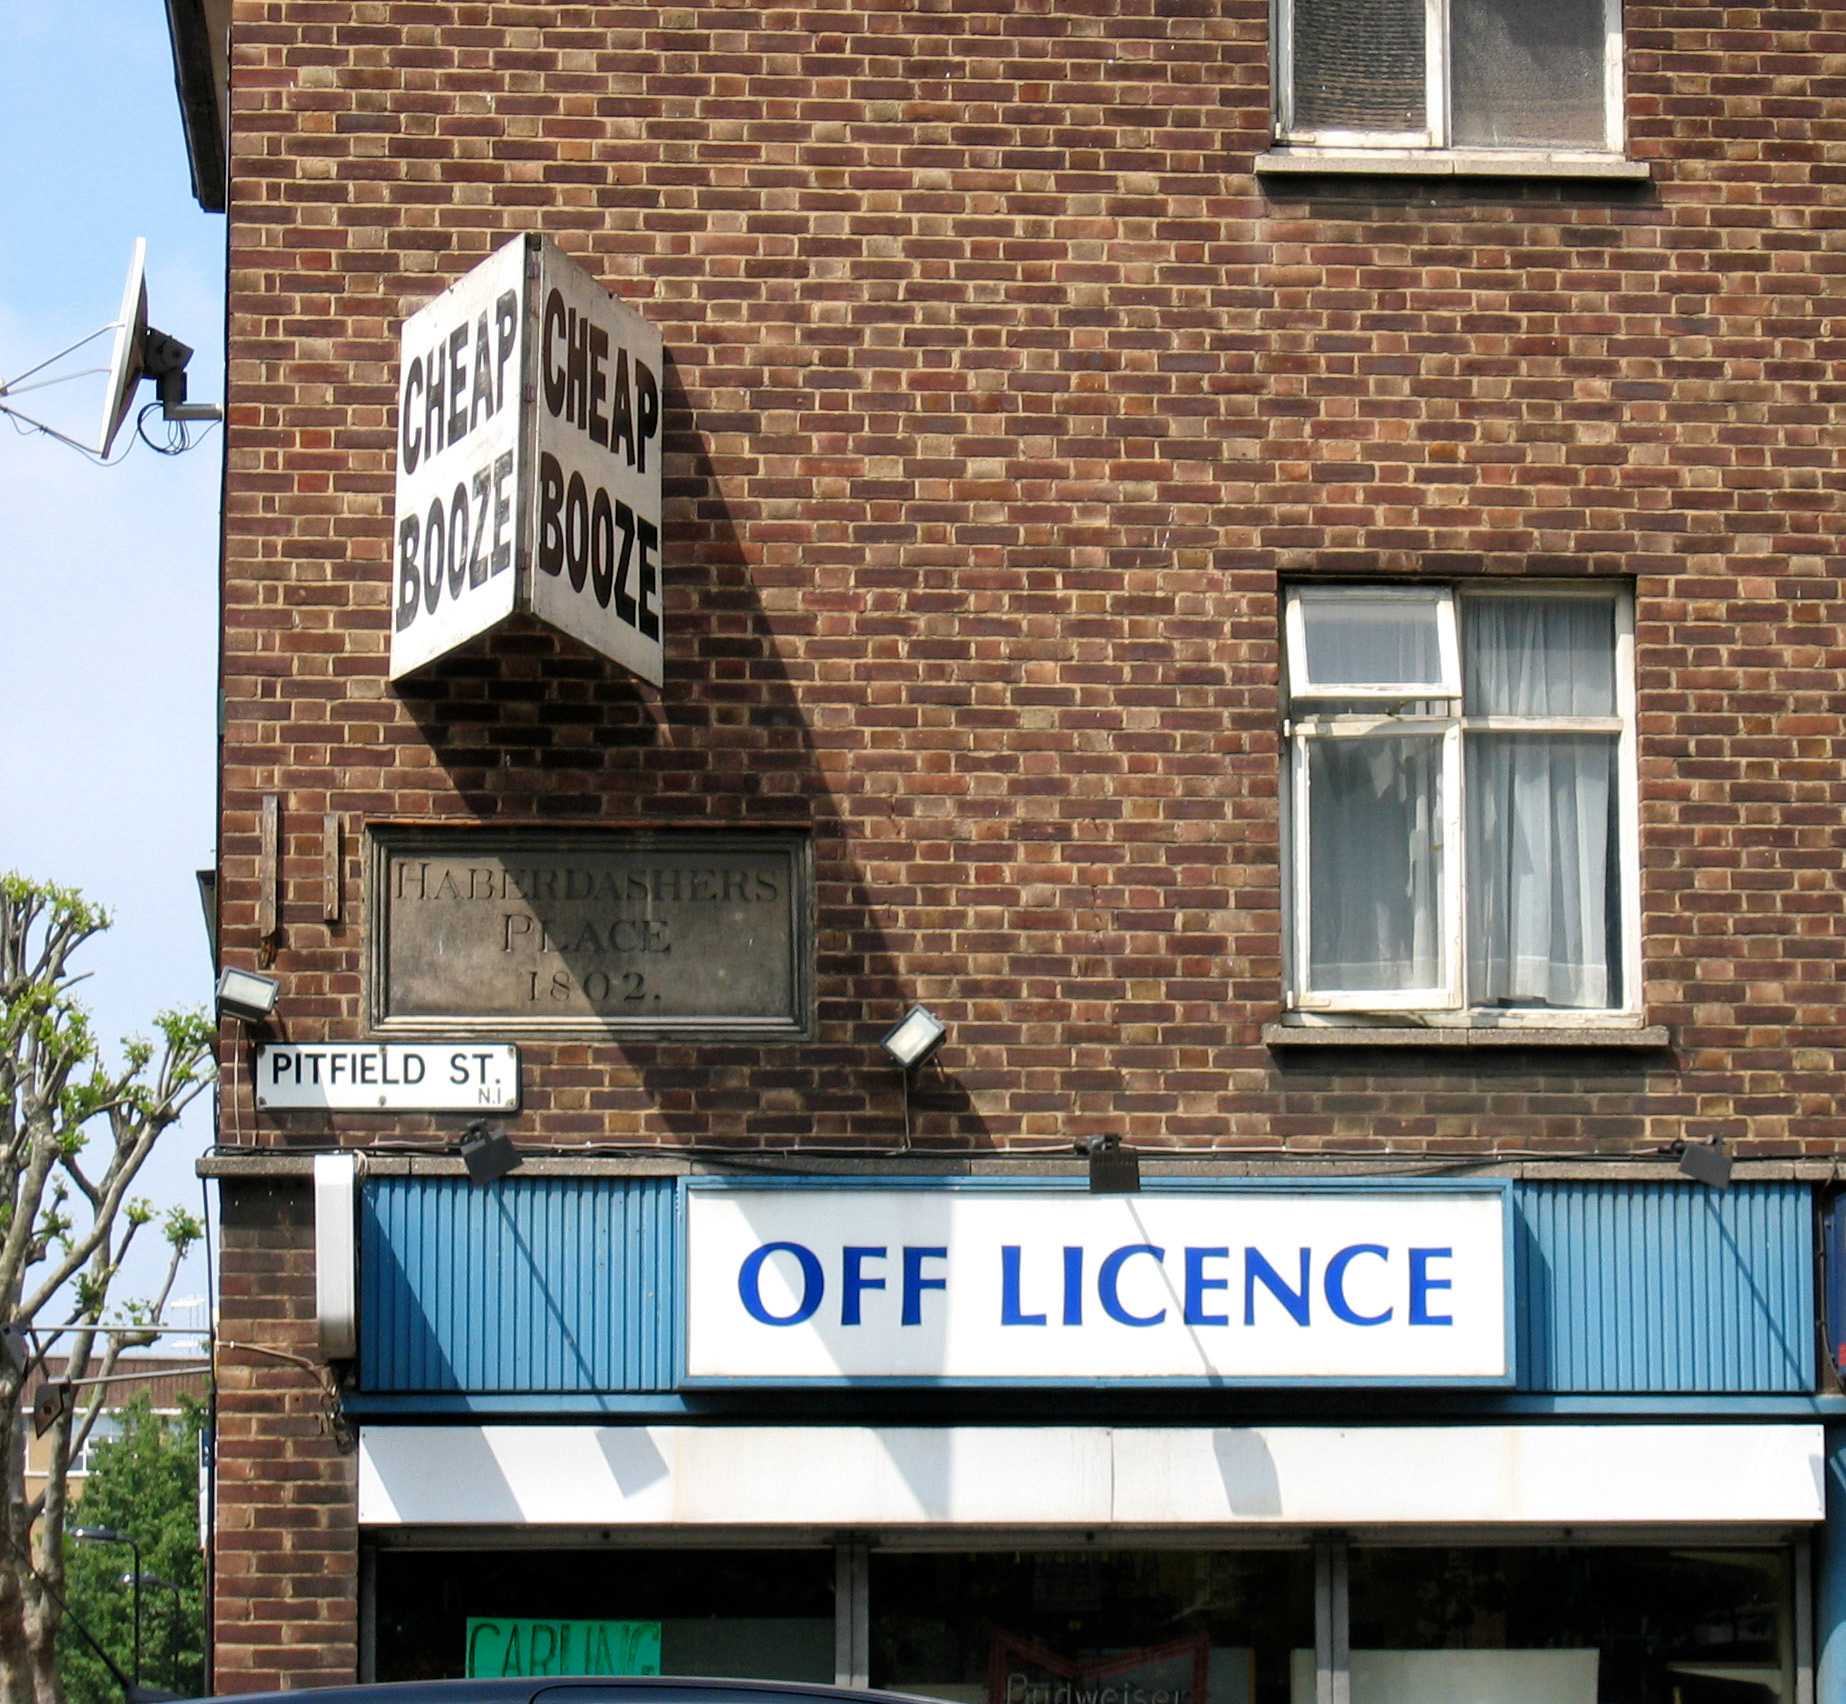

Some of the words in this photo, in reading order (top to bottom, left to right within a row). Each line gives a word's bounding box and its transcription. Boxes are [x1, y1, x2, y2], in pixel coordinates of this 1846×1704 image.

[403, 288, 518, 475] CHEAP
[542, 287, 659, 474] CHEAP
[396, 448, 514, 633] BOOZE
[539, 451, 660, 643] BOOZE
[394, 862, 778, 904] HABERDASHERS
[502, 914, 672, 954] PLACE
[272, 1053, 426, 1085] PITFIELD
[449, 1053, 501, 1085] ST.
[738, 1241, 947, 1327] OFF
[1000, 1242, 1454, 1327] LICENCE
